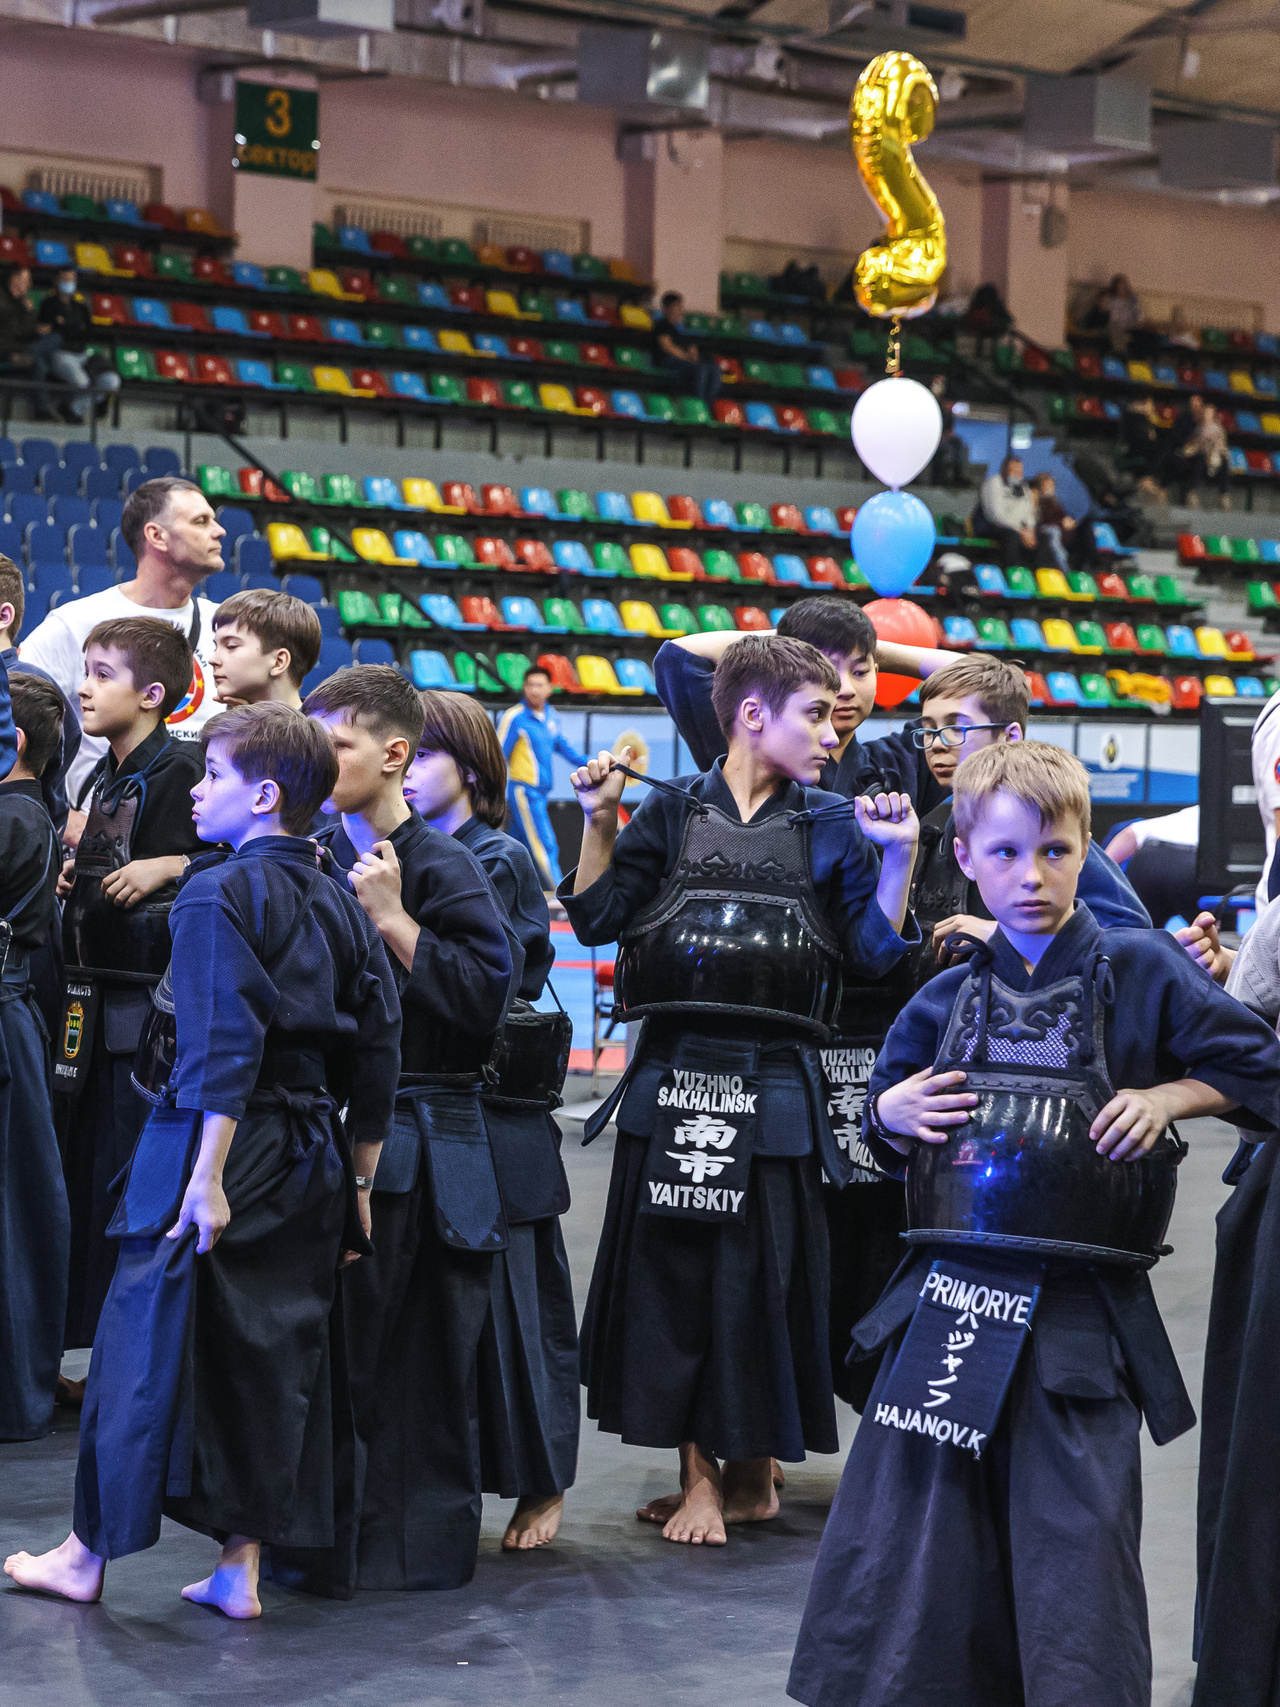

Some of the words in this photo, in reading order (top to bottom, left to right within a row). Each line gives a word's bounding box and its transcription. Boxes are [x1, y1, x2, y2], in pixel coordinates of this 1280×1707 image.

[265, 90, 291, 137] 3
[820, 1047, 876, 1067] YUZHNO
[673, 1069, 743, 1095] YUZHNO
[657, 1086, 758, 1114] SAKHALINSK
[648, 1181, 745, 1213] YAITSKIY
[919, 1271, 1033, 1323] PRIMORYE
